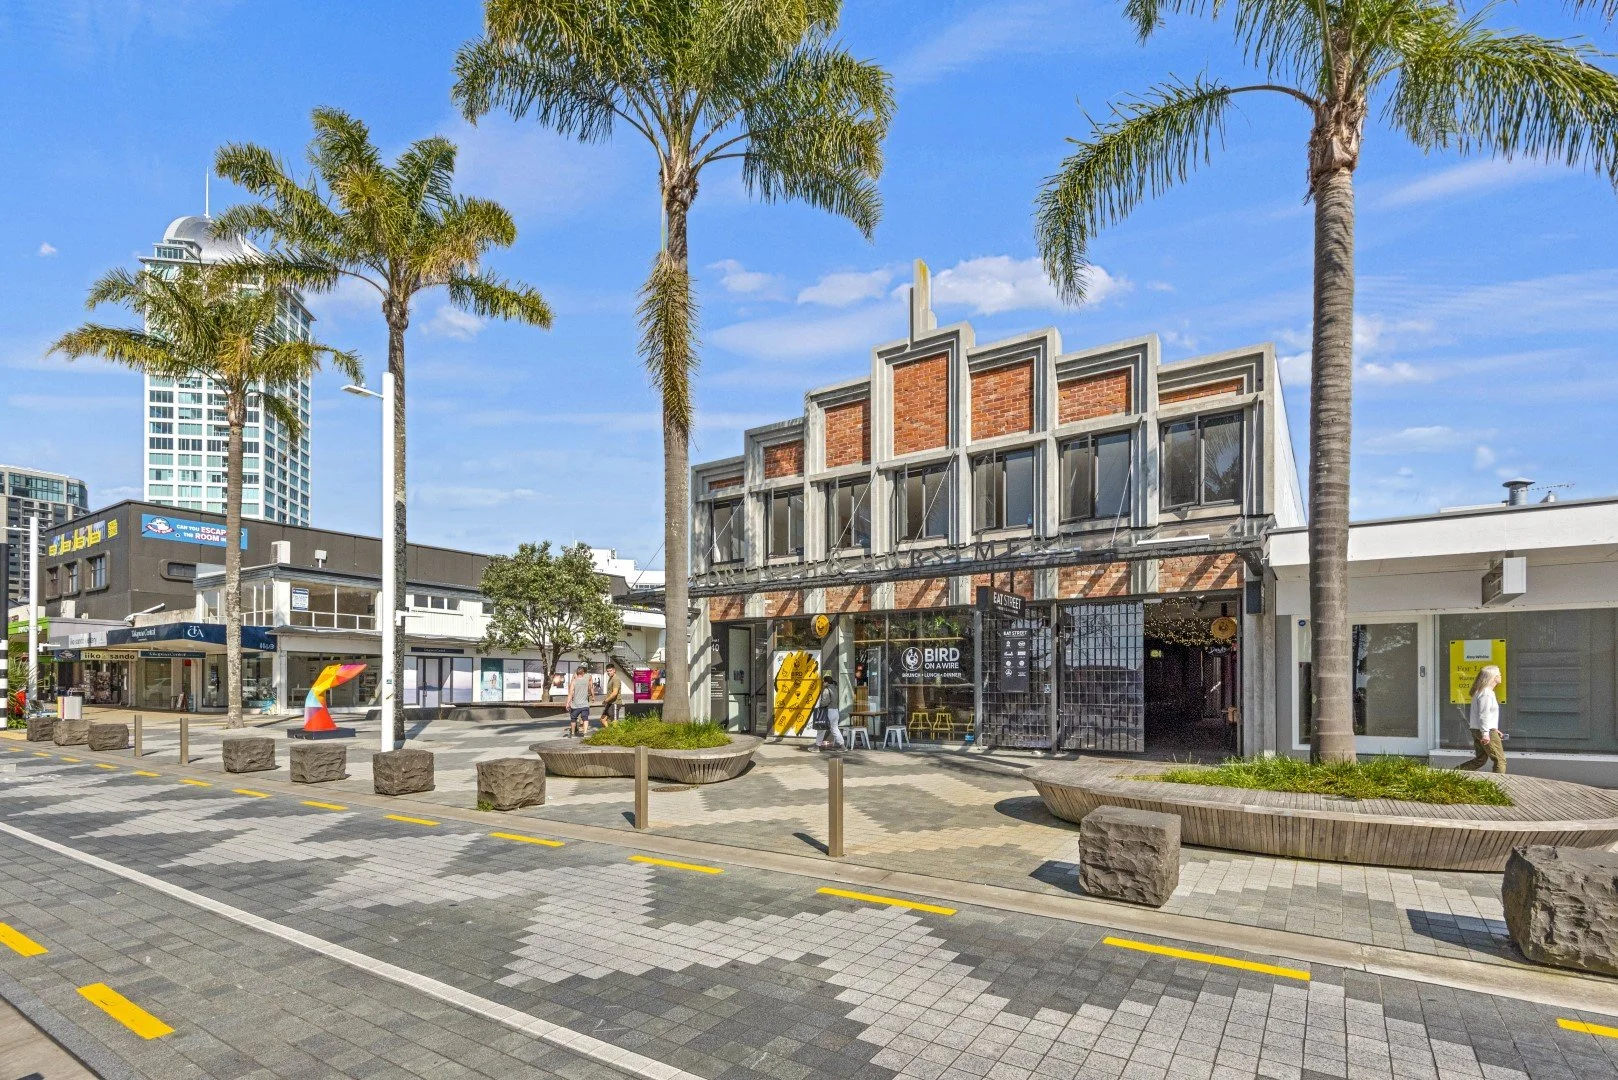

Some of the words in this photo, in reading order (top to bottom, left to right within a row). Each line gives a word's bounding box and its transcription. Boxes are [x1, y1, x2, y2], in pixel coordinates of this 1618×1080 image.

[195, 532, 219, 542] ROOM
[201, 526, 227, 536] ESCAP
[993, 591, 1003, 605] EAT
[1003, 594, 1021, 609] STREET
[924, 647, 960, 662] BIRD
